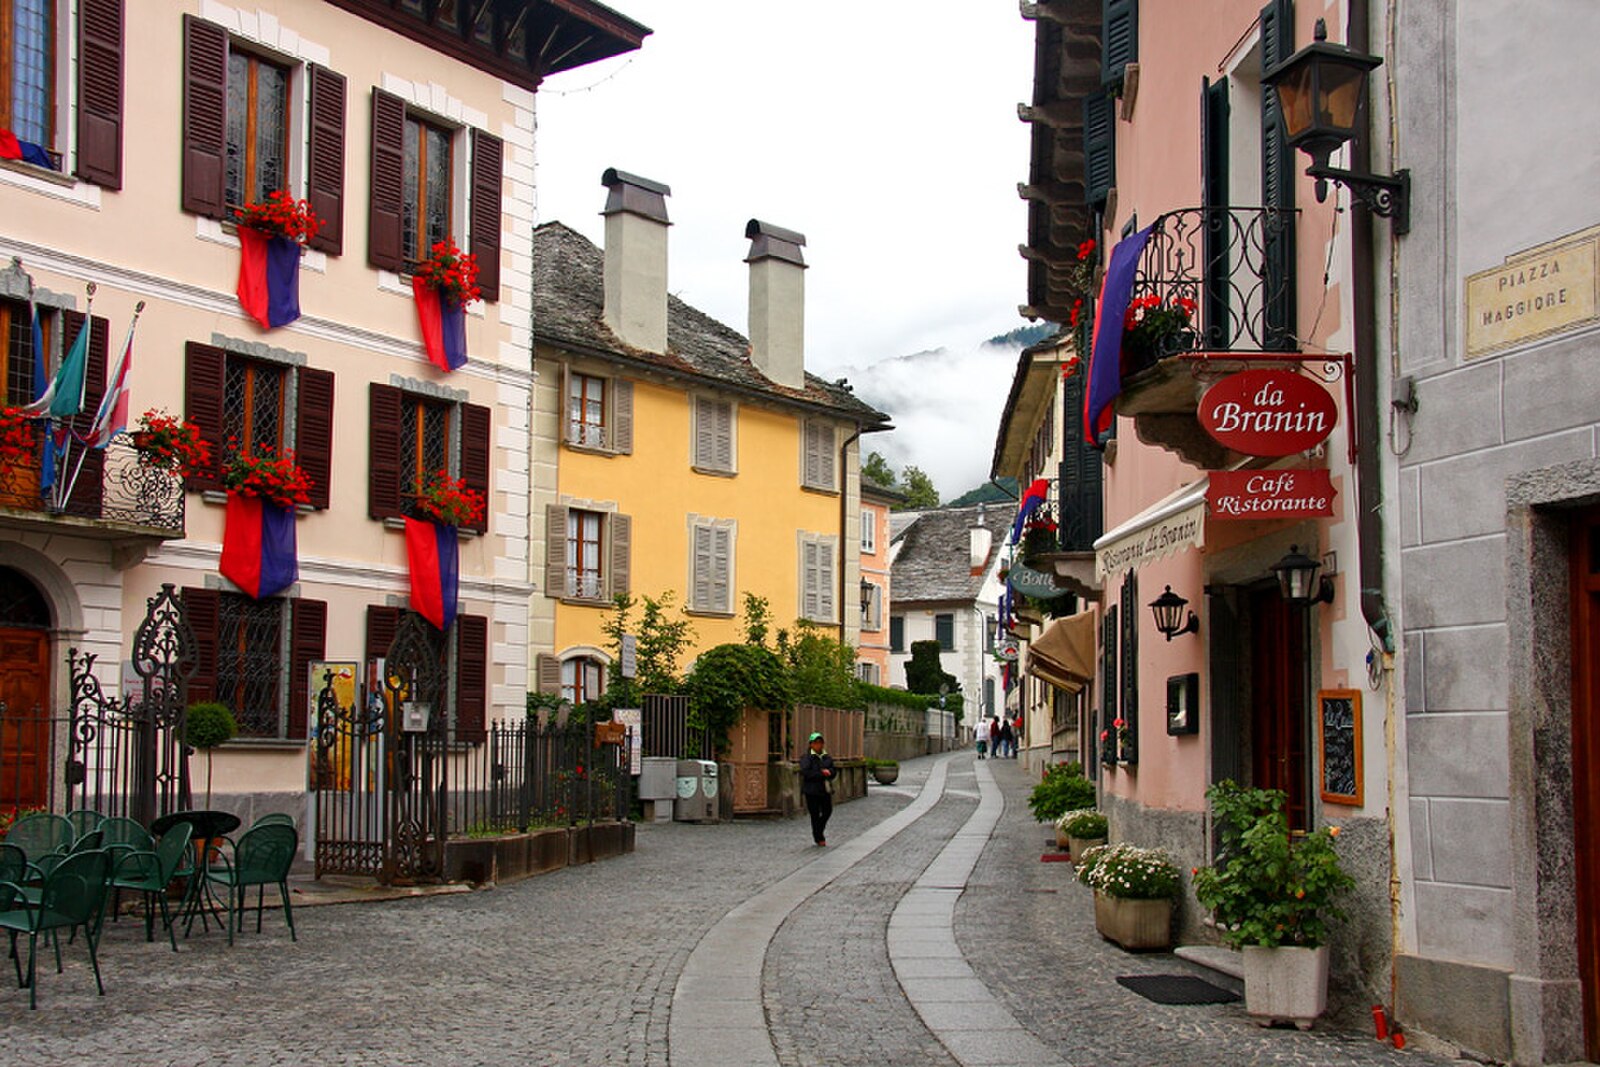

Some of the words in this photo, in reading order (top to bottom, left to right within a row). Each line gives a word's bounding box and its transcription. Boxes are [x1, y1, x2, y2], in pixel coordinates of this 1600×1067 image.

[1498, 260, 1560, 292] PIAZZA
[1482, 288, 1567, 326] MAGGIORE
[1253, 380, 1285, 407] da
[1212, 401, 1328, 433] Branin
[1246, 472, 1295, 497] Café
[1216, 495, 1327, 516] Ristorante
